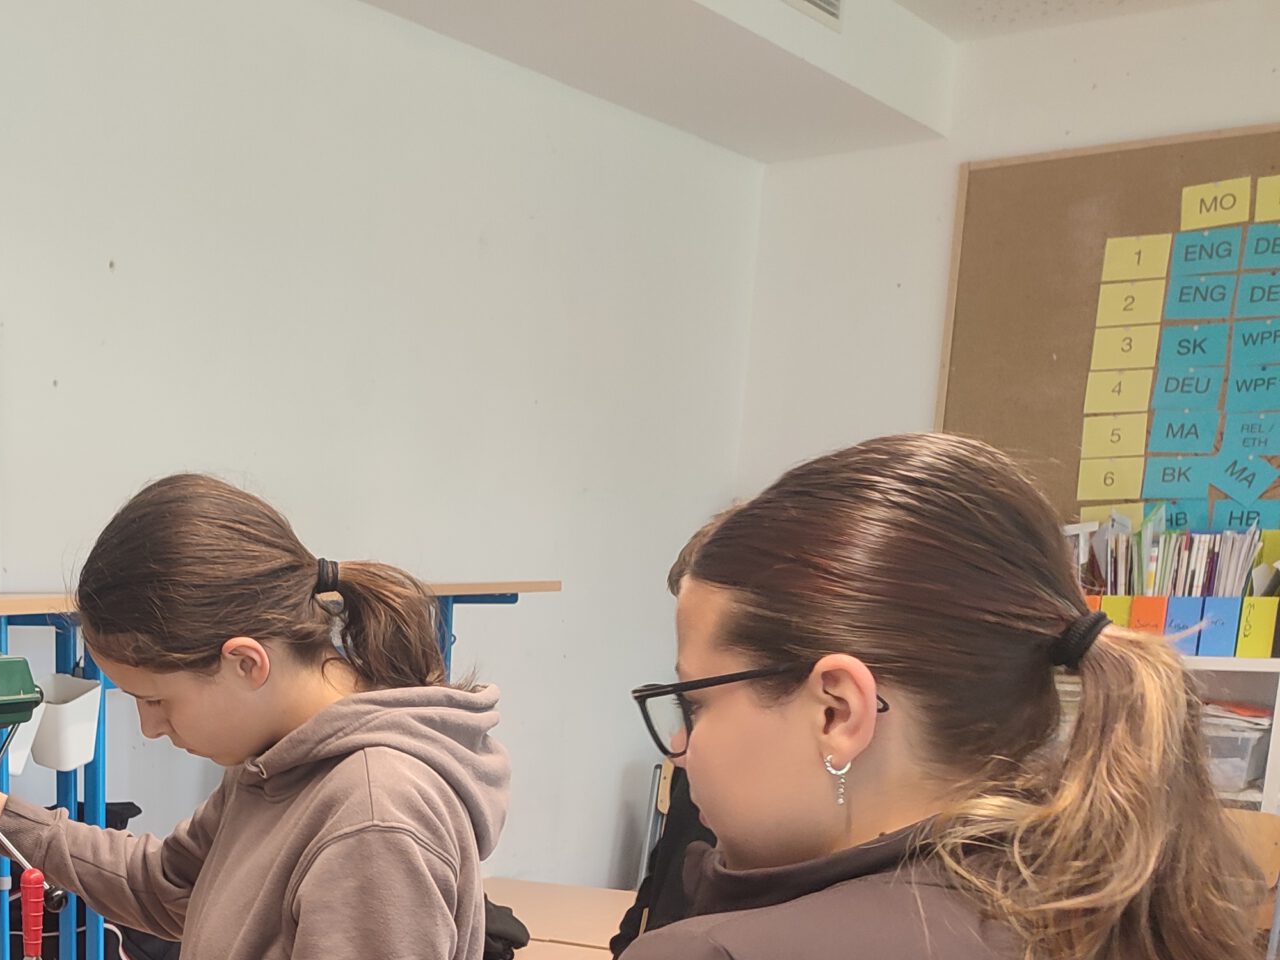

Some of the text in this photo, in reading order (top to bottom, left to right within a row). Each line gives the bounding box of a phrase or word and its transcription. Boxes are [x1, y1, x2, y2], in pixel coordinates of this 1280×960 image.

[1199, 193, 1236, 214] MO
[1134, 249, 1142, 266] 1
[1184, 241, 1232, 262] ENG
[1178, 284, 1226, 303] ENG
[1122, 295, 1135, 311] 2
[1121, 337, 1132, 353] 3
[1176, 338, 1207, 356] SK
[1111, 380, 1122, 396] 4
[1164, 377, 1211, 394] DEU
[1110, 428, 1121, 443] 5
[1166, 422, 1199, 440] MA
[1241, 423, 1265, 433] REL
[1242, 437, 1268, 448] ETH
[1103, 471, 1115, 487] 6
[1161, 466, 1192, 483] BK
[1224, 459, 1257, 489] MA
[1228, 510, 1260, 527] HB
